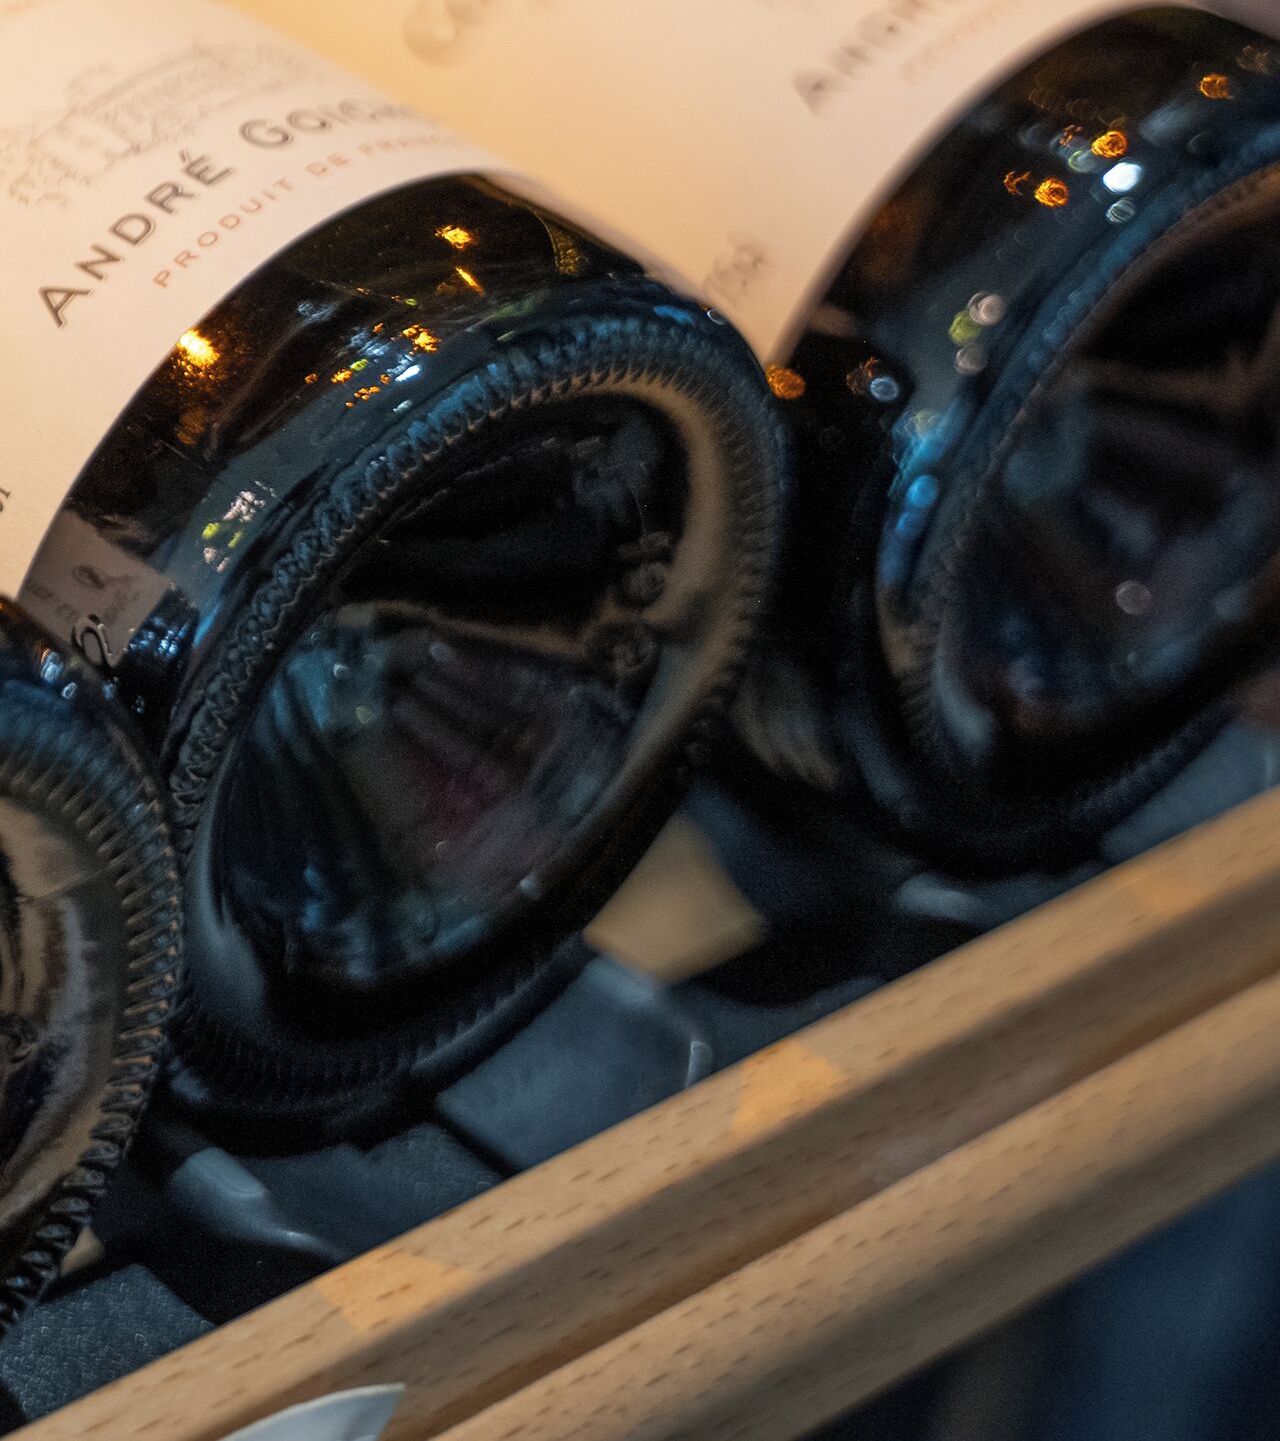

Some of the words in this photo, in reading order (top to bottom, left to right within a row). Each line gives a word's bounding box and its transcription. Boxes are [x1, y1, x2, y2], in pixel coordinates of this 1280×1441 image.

[38, 148, 232, 327] ANDRÉ
[153, 175, 295, 289] PRODUIT
[305, 152, 350, 176] DE
